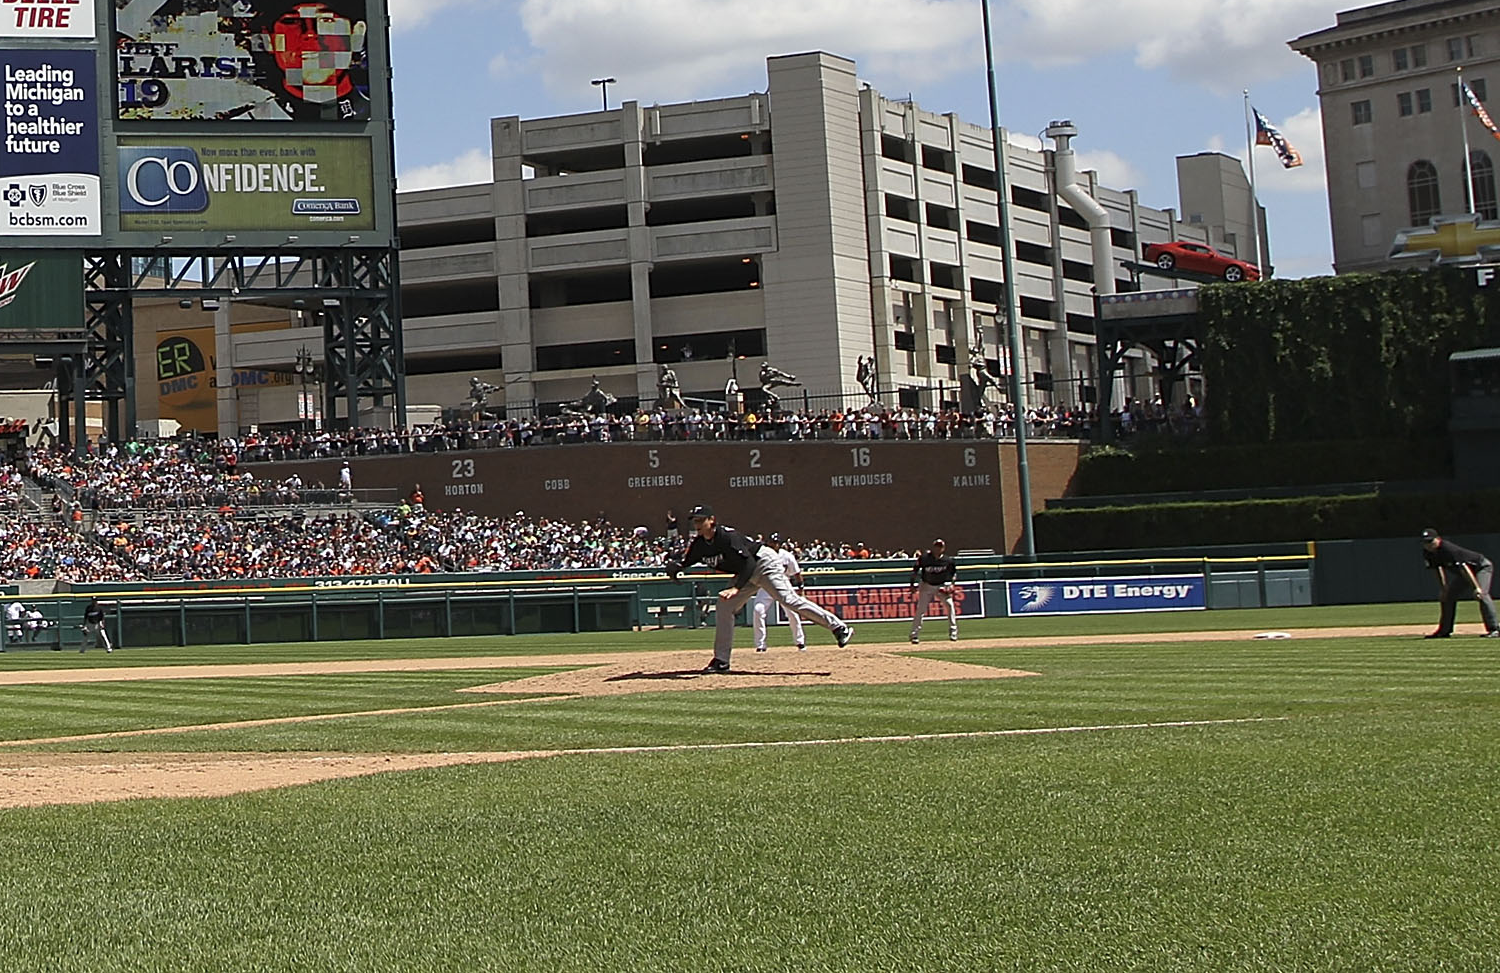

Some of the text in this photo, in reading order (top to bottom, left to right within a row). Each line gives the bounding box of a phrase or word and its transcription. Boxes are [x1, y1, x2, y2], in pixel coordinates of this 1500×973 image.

[14, 7, 71, 28] TIRE
[120, 42, 178, 56] JEFF
[5, 64, 74, 86] Leading
[5, 83, 84, 105] Michigan
[119, 79, 170, 108] 19
[5, 101, 38, 116] to a
[7, 117, 84, 135] healthier
[6, 135, 60, 153] future
[201, 148, 216, 156] Now
[220, 148, 237, 156] more
[241, 148, 257, 156] than
[280, 148, 298, 156] bank
[300, 148, 316, 156] with
[335, 202, 354, 210] Bank
[10, 212, 87, 226] bcbsm.com
[158, 343, 192, 378] ER
[160, 376, 198, 395] DMC
[649, 450, 660, 468] 5
[750, 449, 761, 468] 2
[851, 448, 870, 467] 16
[965, 448, 976, 467] 6
[452, 459, 475, 478] 23
[545, 479, 570, 490] COBB
[628, 475, 683, 488] GREENBERG
[730, 474, 784, 487] GEHRINGER
[831, 473, 892, 487] NEWHOUSER
[953, 474, 990, 487] KALINE
[445, 484, 484, 496] HORTON
[1063, 584, 1190, 599] DTE Energy
